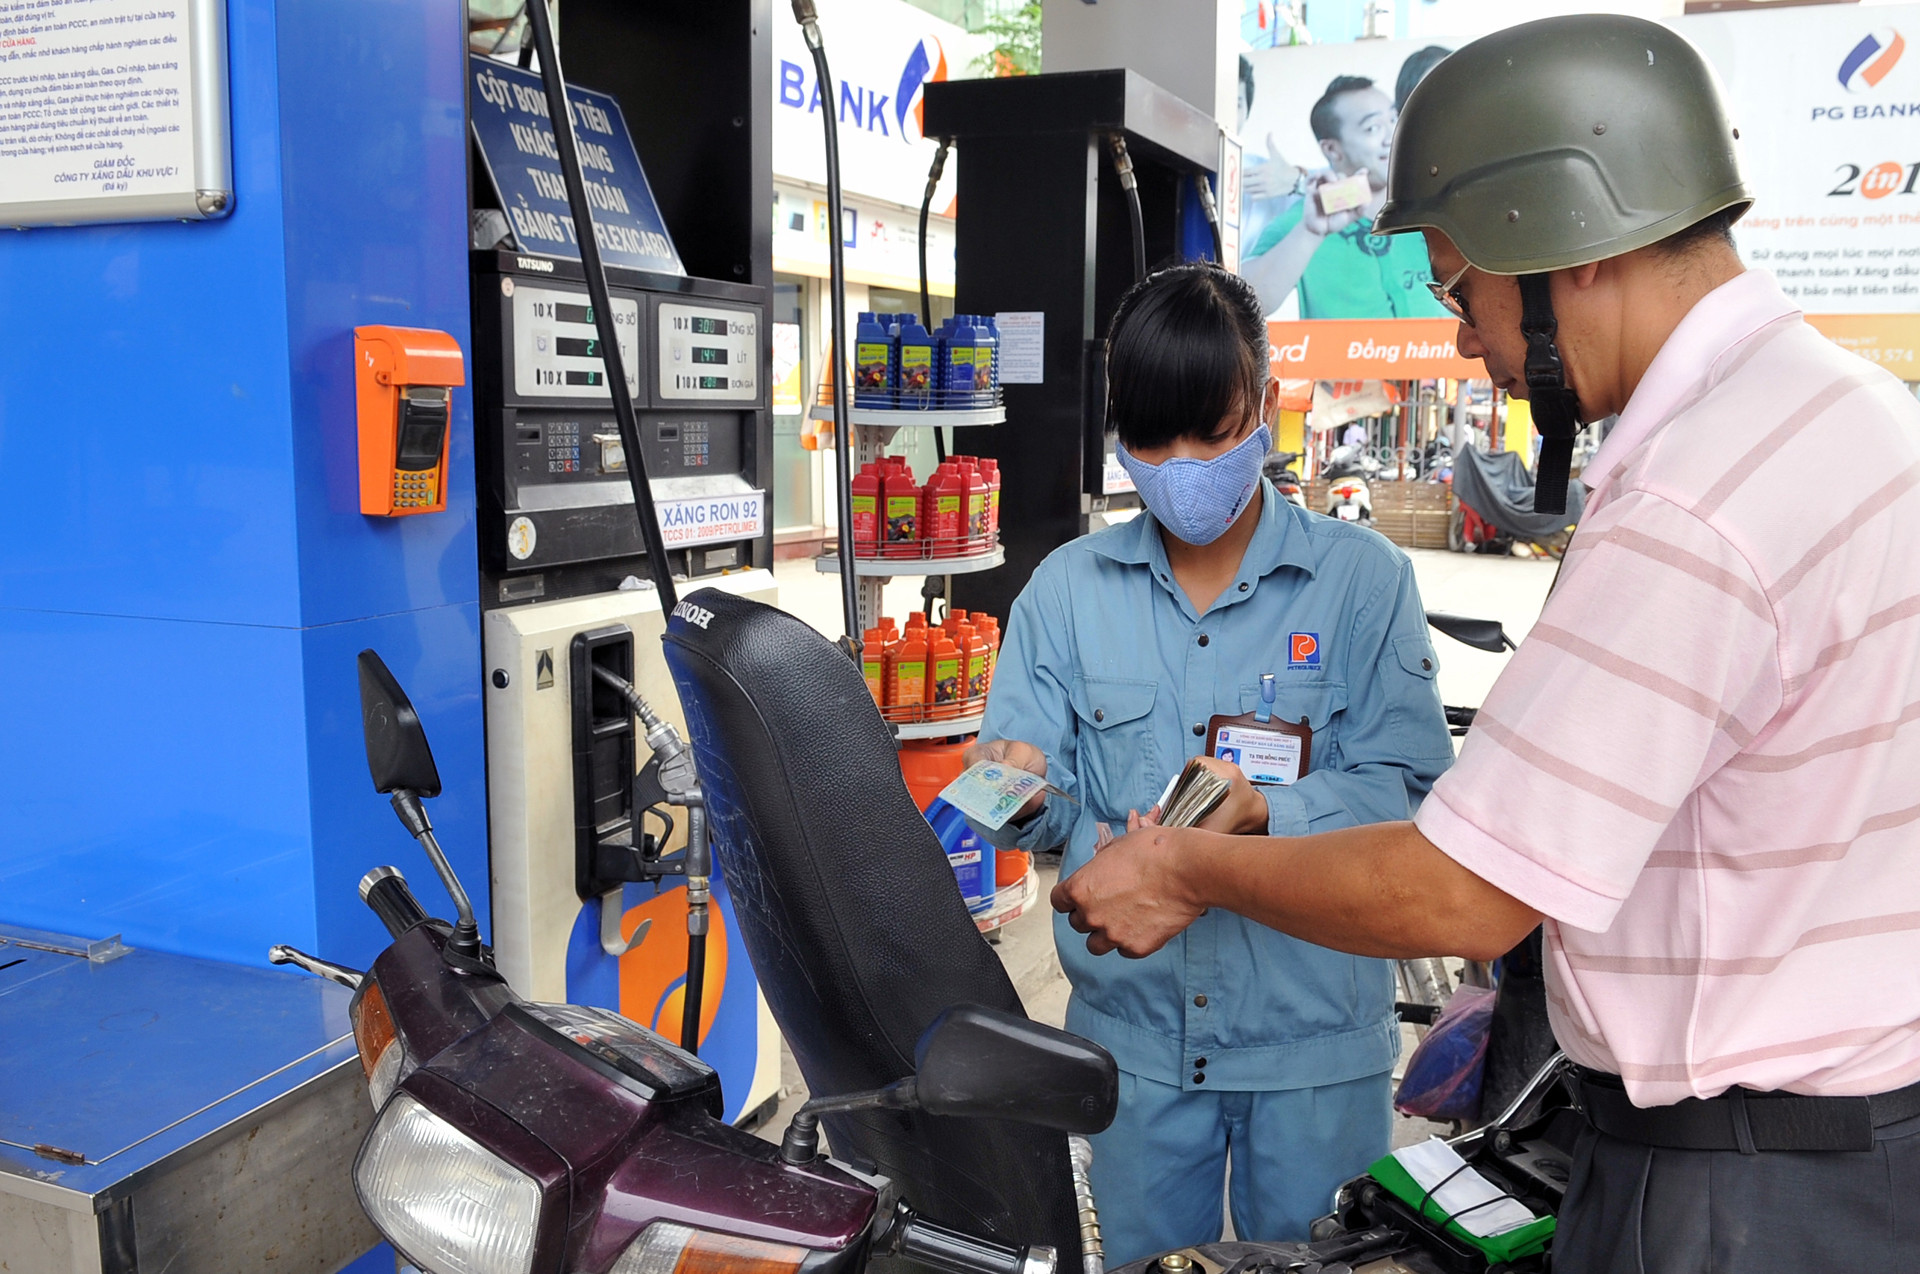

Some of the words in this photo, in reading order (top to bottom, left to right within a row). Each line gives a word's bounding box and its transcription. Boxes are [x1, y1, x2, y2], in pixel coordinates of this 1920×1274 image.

[476, 68, 514, 113] CỘT
[1811, 106, 1844, 121] PG
[509, 121, 559, 161] KHÁC
[575, 132, 615, 173] ÀNG
[526, 167, 568, 202] THA
[511, 193, 565, 243] BẰNG
[592, 222, 672, 260] FLEXICARD
[517, 257, 554, 273] TATSUNO
[533, 302, 544, 318] 10
[673, 317, 682, 330] 10
[587, 339, 595, 356] 2
[1347, 338, 1400, 364] Đồng
[1405, 340, 1455, 359] hành
[543, 370, 554, 385] 10
[663, 503, 705, 527] XĂNG
[710, 502, 739, 522] RON
[743, 500, 757, 518] 92
[663, 529, 683, 541] TCCS
